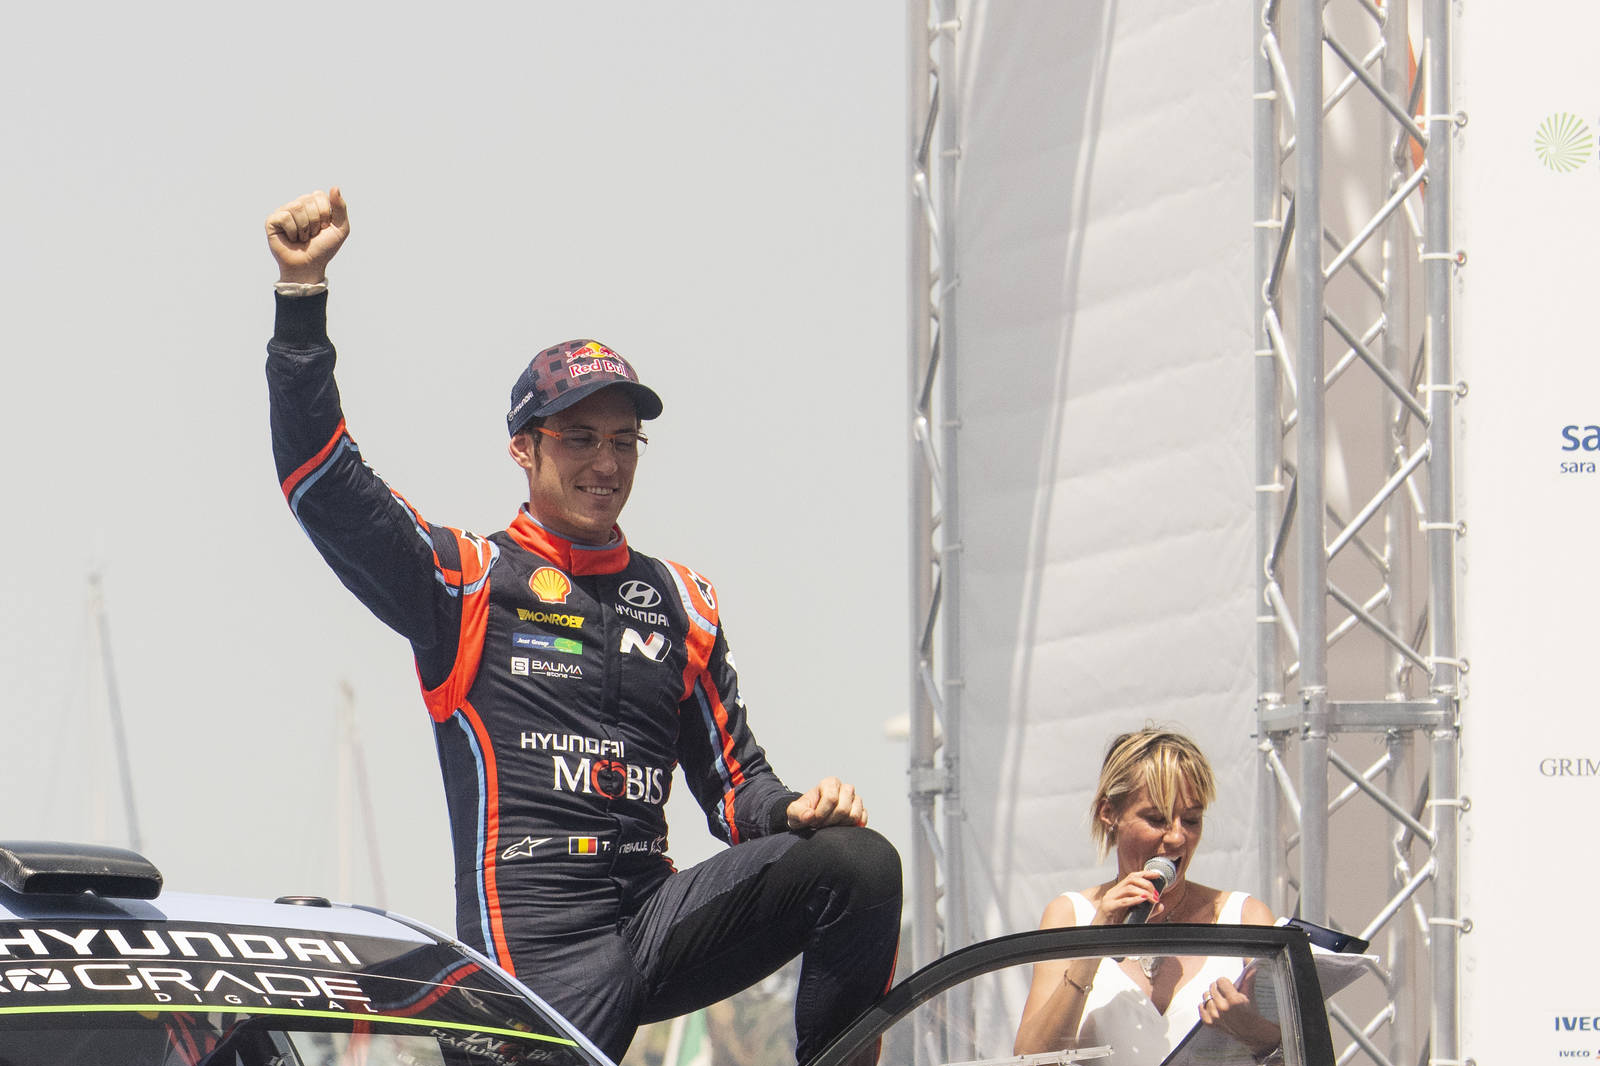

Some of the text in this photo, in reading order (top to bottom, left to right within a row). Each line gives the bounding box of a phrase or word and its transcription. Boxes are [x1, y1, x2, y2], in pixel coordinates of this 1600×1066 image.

[569, 359, 629, 378] Red Bull
[1561, 424, 1600, 451] sa
[1560, 461, 1596, 474] sara
[522, 609, 581, 628] MONROE
[615, 602, 670, 628] HYUNDAI
[532, 660, 583, 675] BAUMA
[521, 732, 625, 758] HYUNDAI
[1540, 758, 1600, 777] GRIM
[552, 755, 664, 805] MOBIS
[156, 993, 378, 1014] DIGITAL
